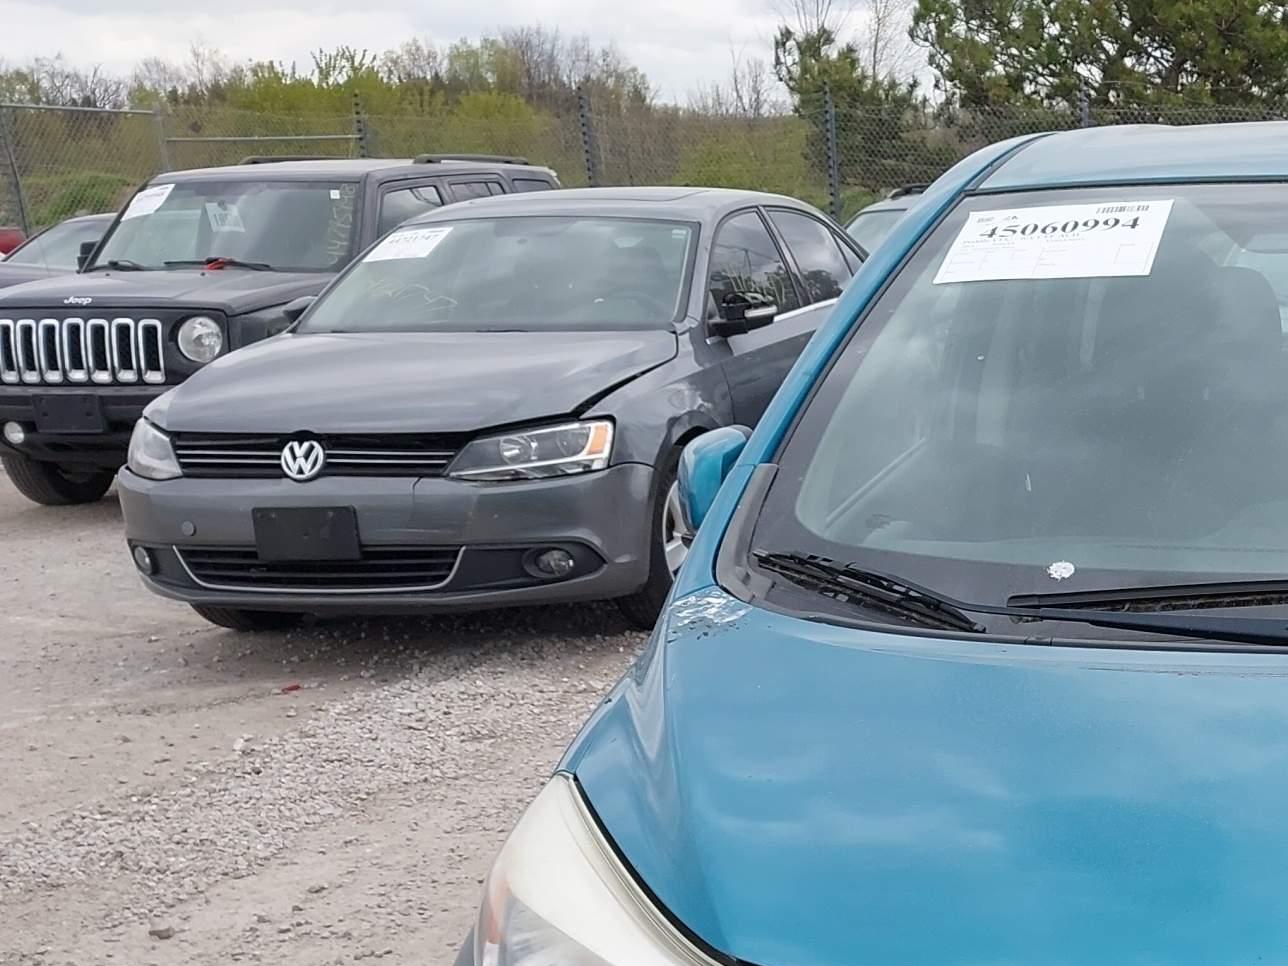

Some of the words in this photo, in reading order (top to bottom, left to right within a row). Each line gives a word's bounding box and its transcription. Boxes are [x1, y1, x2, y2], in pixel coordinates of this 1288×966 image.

[979, 216, 1140, 239] 45060994
[64, 296, 92, 306] Jeep
[281, 440, 324, 479] VW
